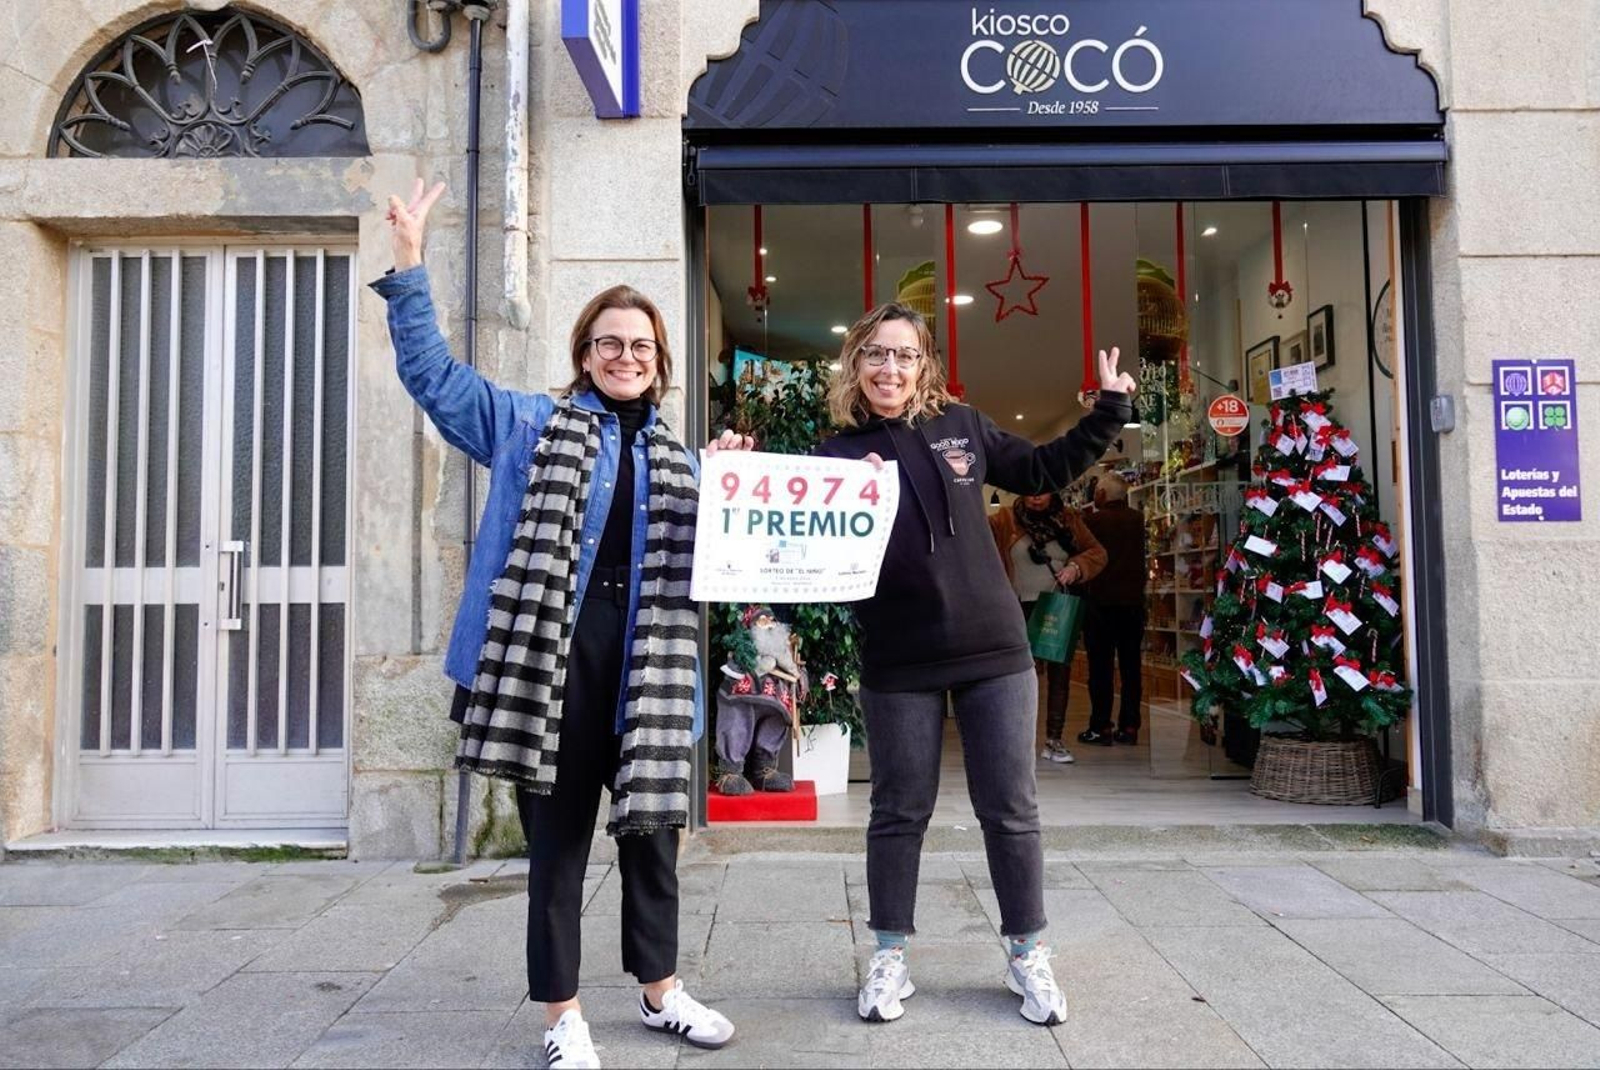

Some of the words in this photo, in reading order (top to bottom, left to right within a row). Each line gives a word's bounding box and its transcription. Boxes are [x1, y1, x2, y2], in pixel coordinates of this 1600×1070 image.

[971, 7, 1070, 36] kiosco
[1027, 101, 1065, 115] Desde
[1069, 101, 1099, 115] 1958
[1501, 468, 1549, 481] Loterías
[1551, 471, 1560, 483] y
[721, 471, 880, 506] 94974
[1502, 486, 1556, 500] Apuestas
[1558, 485, 1578, 497] del
[1502, 504, 1543, 516] Estado
[747, 509, 874, 537] PREMIO
